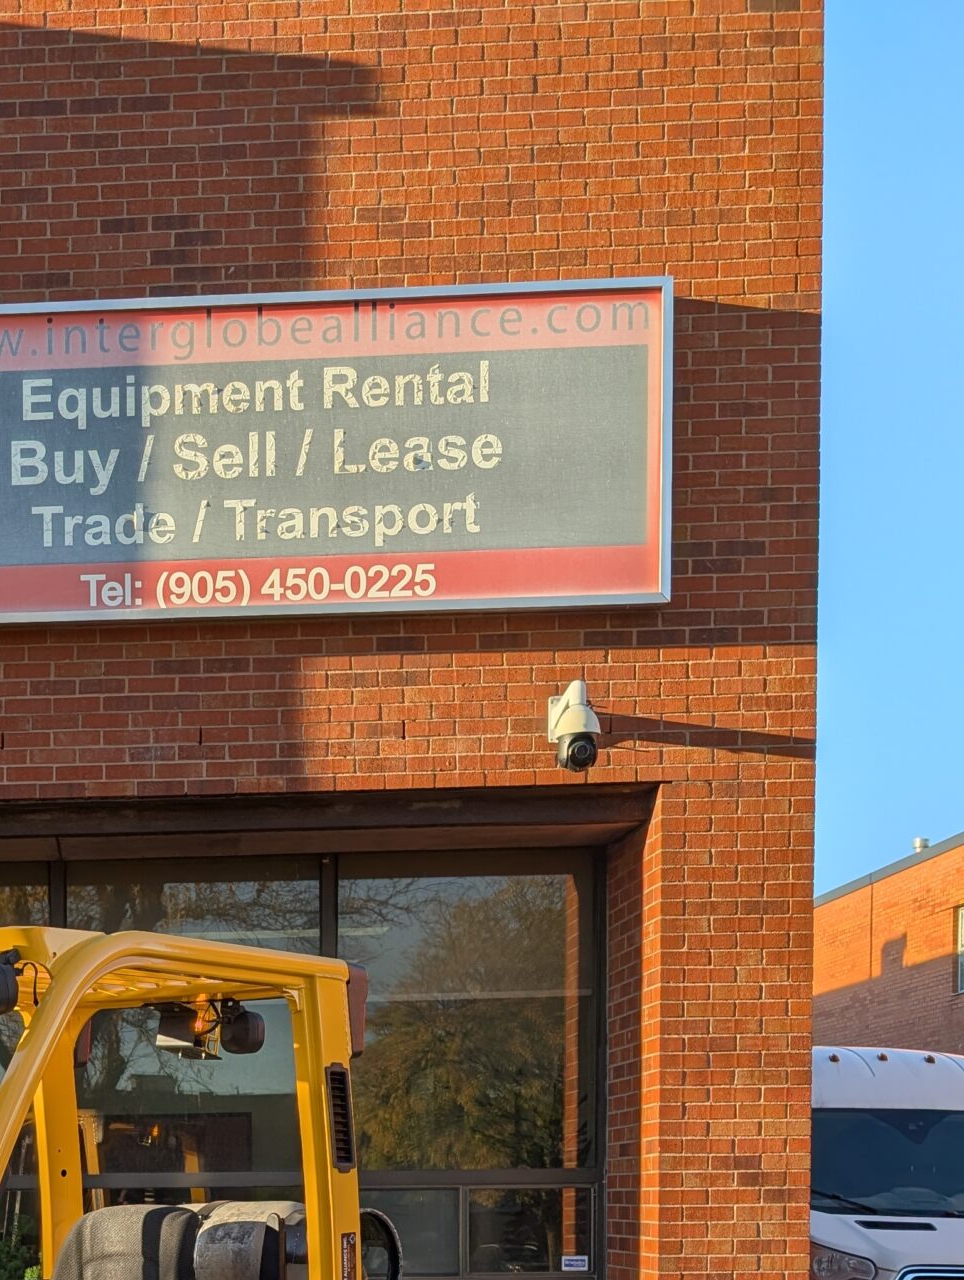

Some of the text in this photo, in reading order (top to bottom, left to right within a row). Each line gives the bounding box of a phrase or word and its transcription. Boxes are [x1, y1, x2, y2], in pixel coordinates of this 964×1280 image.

[21, 360, 490, 430] Equipment Rental
[10, 428, 504, 496] Buy / Sell / Lease
[31, 491, 481, 547] Trade / Transport
[80, 563, 437, 609] Tel: (905) 450-0225
